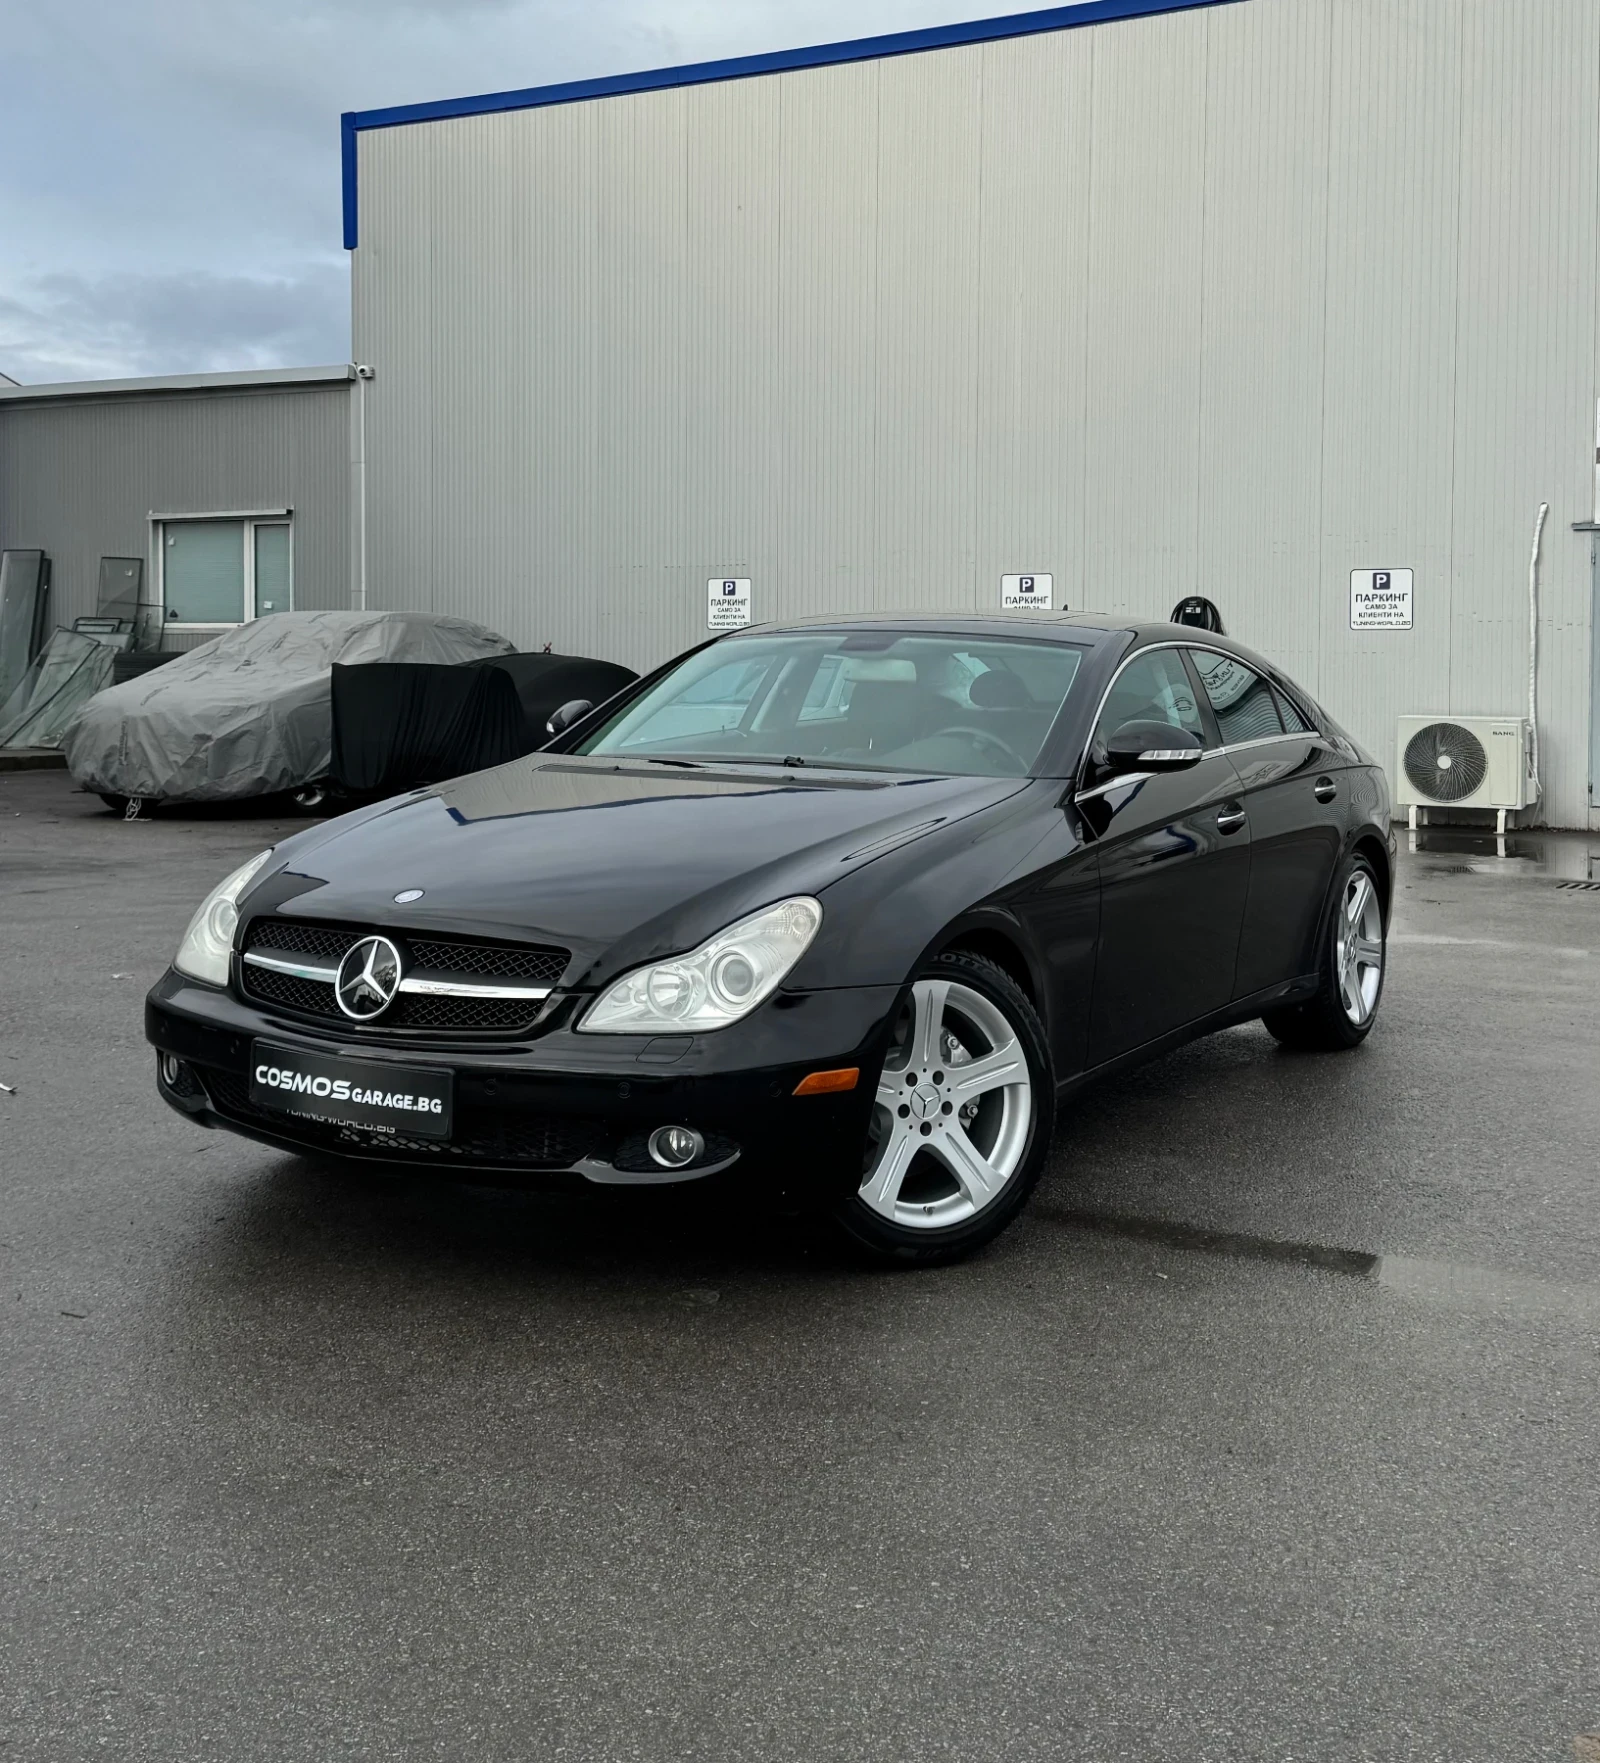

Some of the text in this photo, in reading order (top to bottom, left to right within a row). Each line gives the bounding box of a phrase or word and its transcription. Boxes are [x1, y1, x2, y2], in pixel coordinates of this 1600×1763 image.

[1022, 578, 1032, 592] P
[1376, 574, 1388, 589] P
[725, 582, 734, 595] P
[711, 598, 748, 606] ПАРКИНГ
[1005, 595, 1049, 605] ПАРКИНГ
[1355, 593, 1409, 603] ПАРКИНГ
